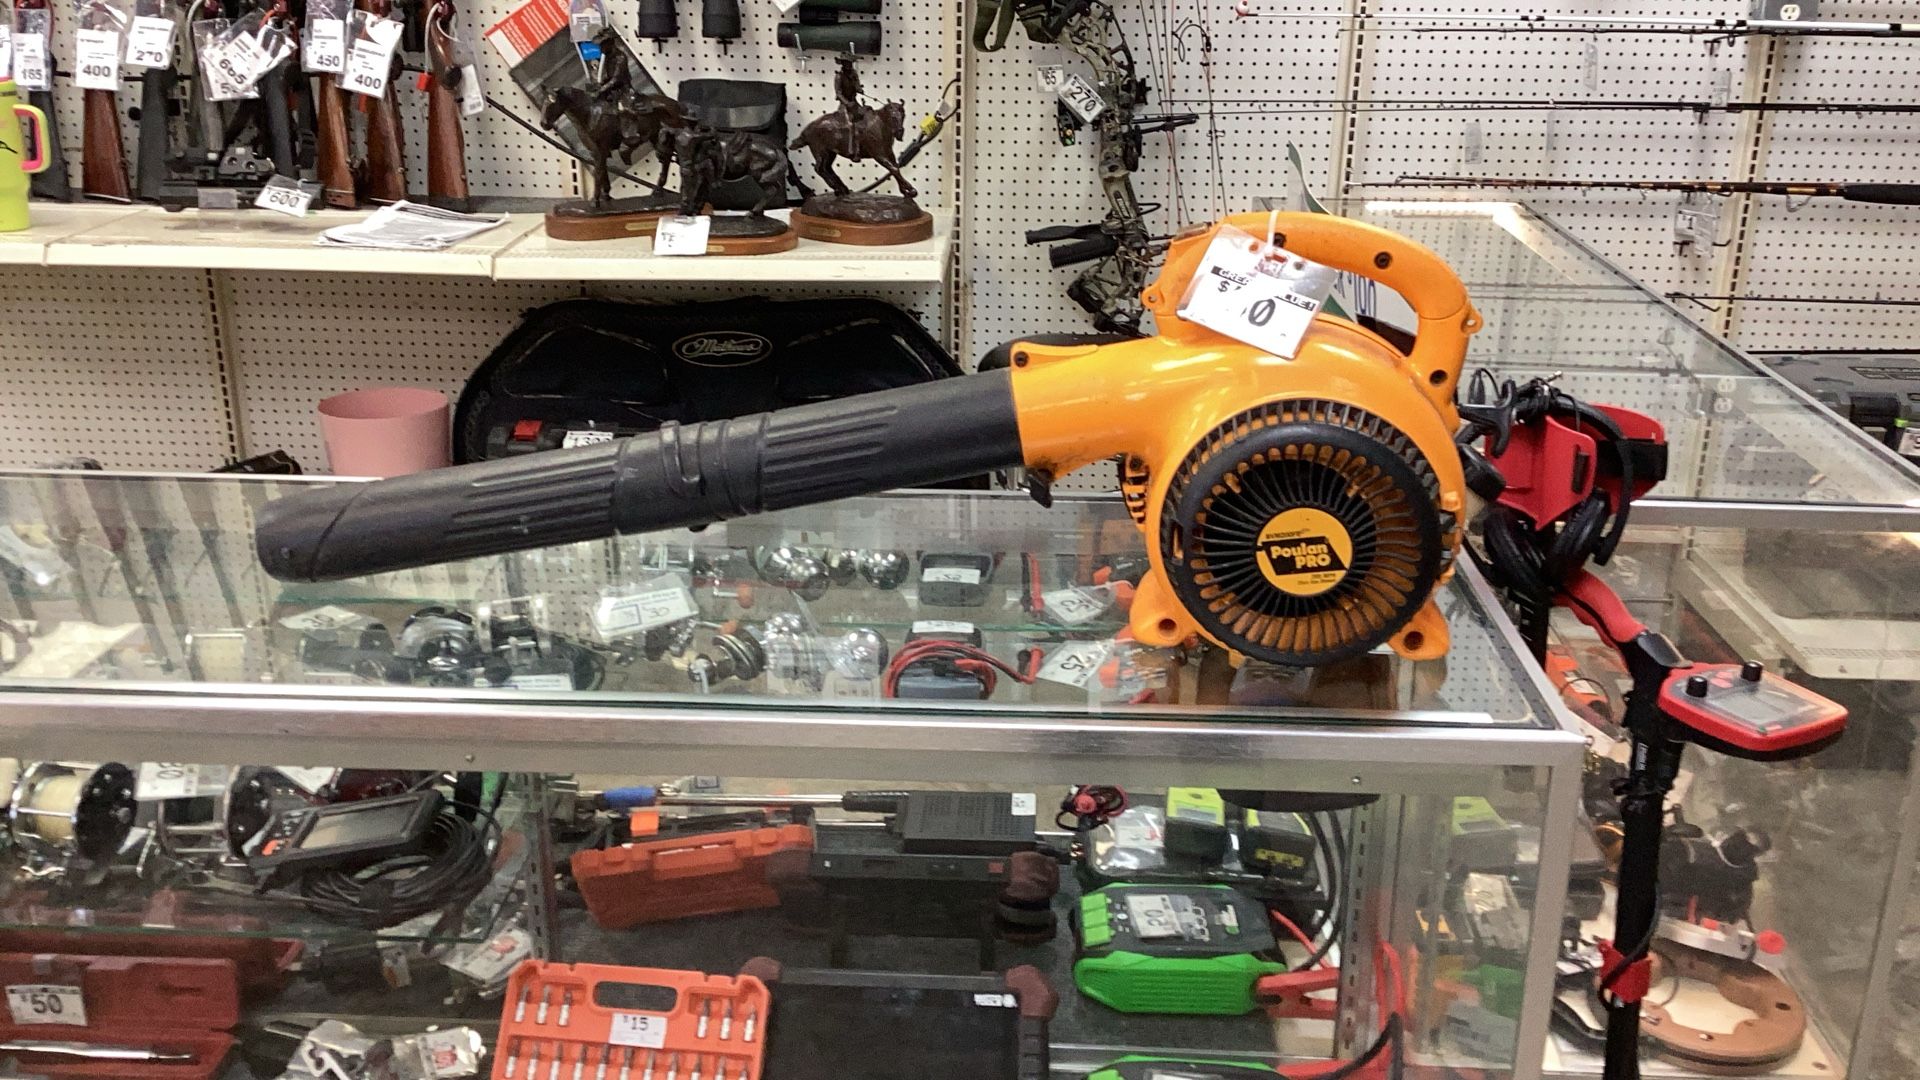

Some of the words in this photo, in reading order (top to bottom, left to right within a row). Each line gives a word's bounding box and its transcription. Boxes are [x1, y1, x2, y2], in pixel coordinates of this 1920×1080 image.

[82, 65, 111, 78] 400
[354, 74, 382, 89] 400
[1270, 542, 1328, 559] Poulan
[1295, 553, 1331, 569] PRO
